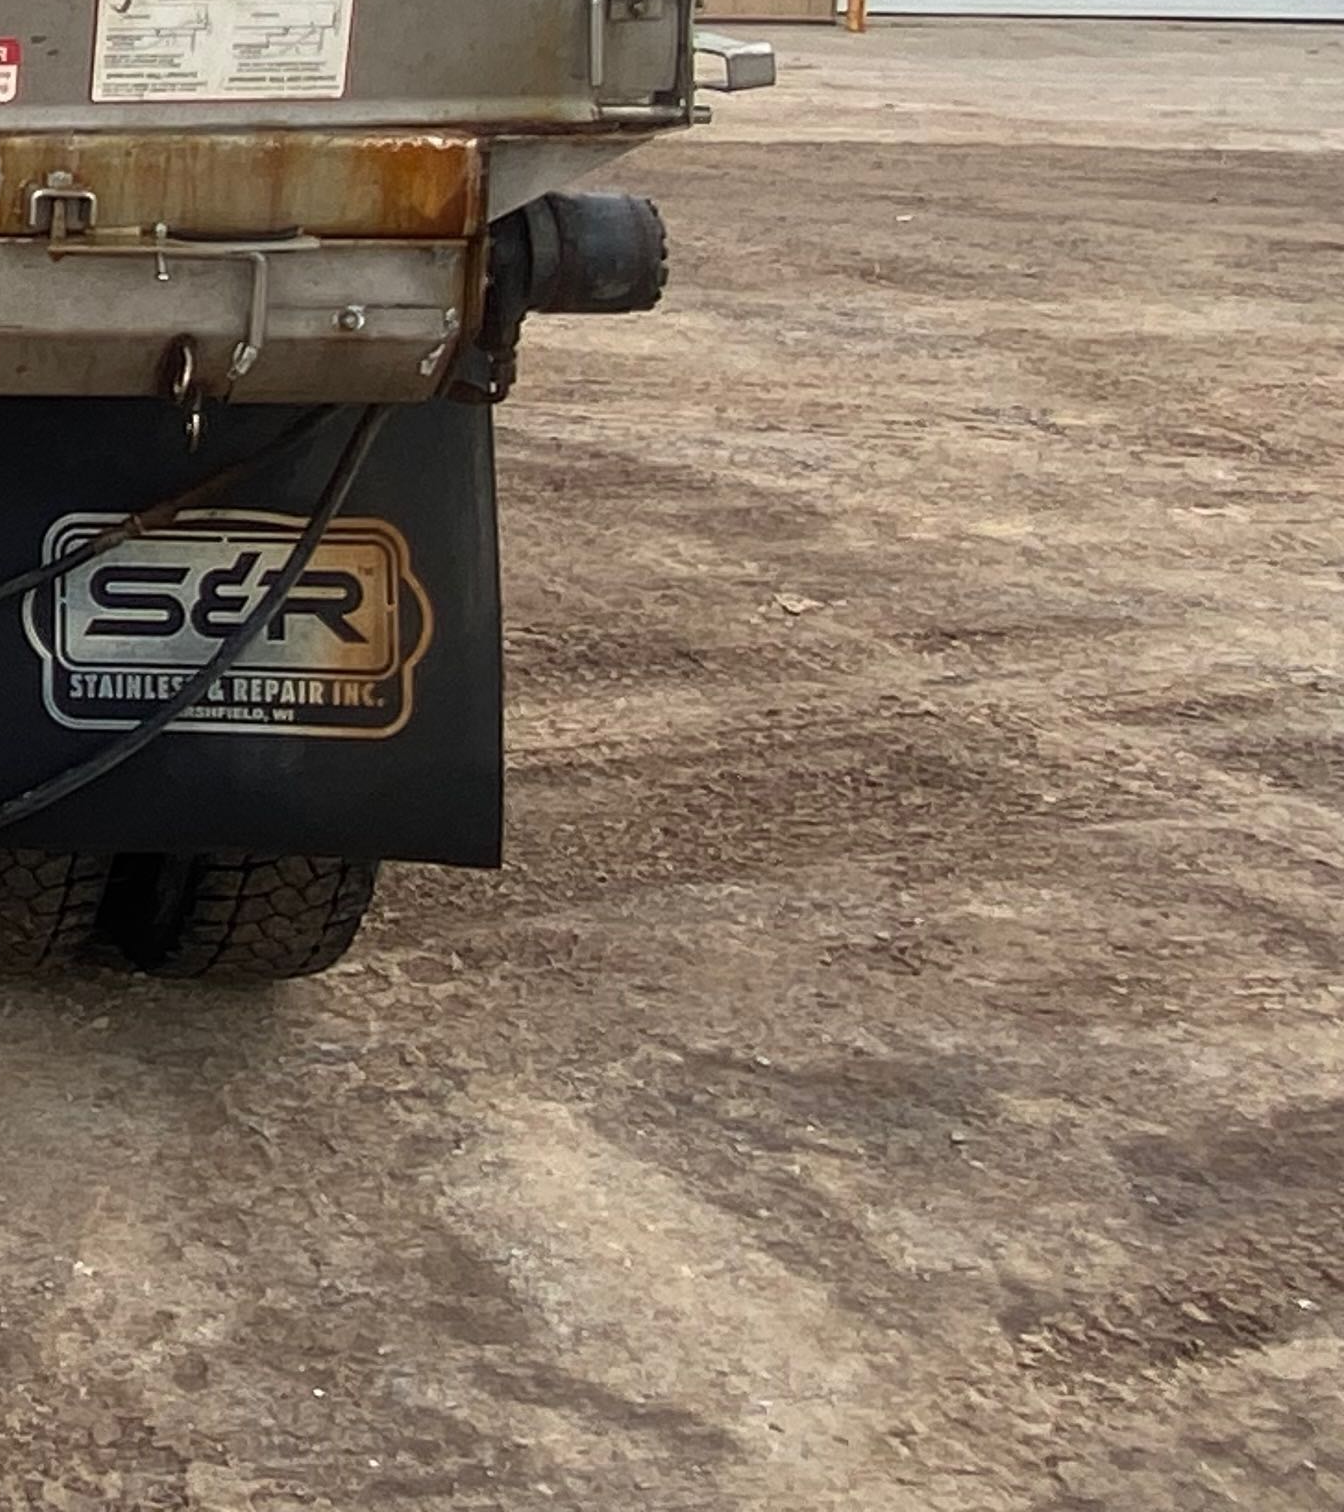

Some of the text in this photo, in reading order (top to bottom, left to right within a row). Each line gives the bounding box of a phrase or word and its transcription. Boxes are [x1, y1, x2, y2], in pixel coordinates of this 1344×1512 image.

[84, 551, 370, 644] S&R
[69, 673, 194, 700] STAINLES
[233, 677, 325, 705] REPAIR
[332, 680, 384, 708] INC.
[272, 707, 295, 722] WI
